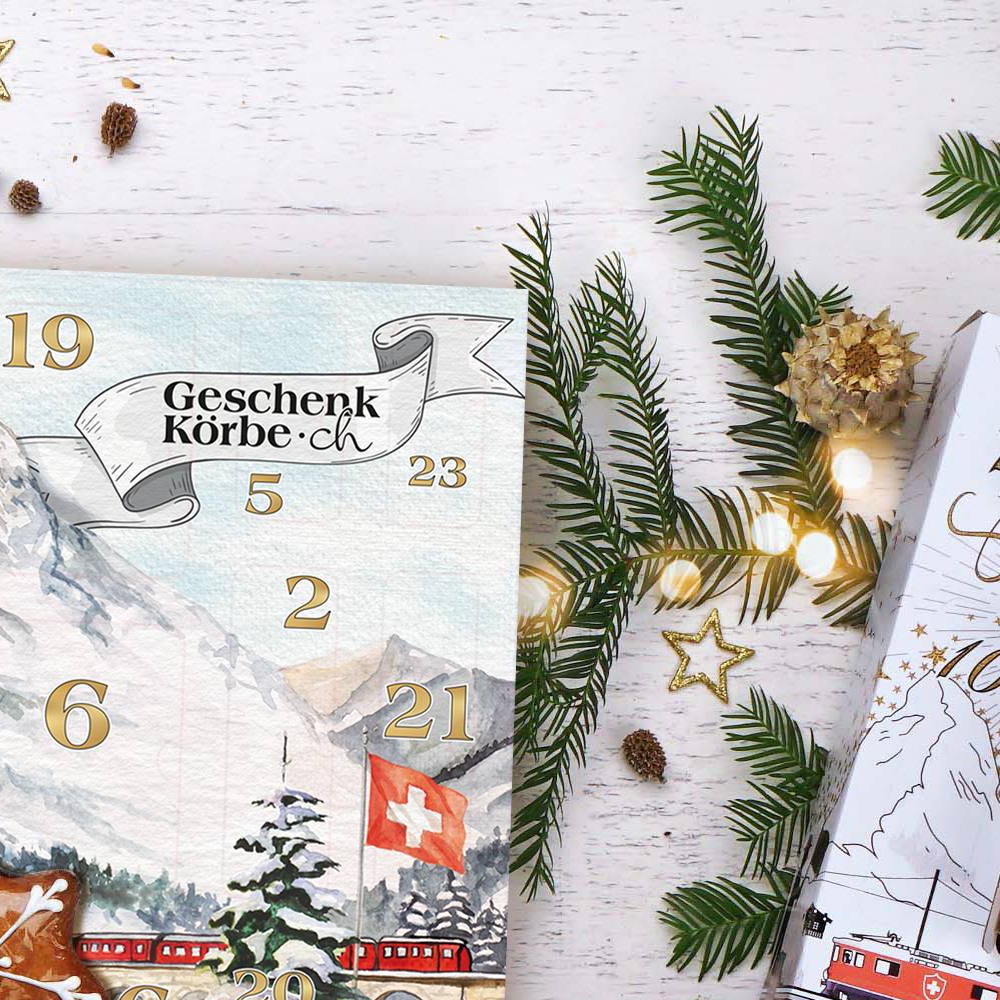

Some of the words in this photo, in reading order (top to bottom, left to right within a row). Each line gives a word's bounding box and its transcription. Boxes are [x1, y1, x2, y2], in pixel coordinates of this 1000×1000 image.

[3, 312, 95, 371] 19
[163, 381, 381, 419] Geschenk
[245, 473, 284, 515] 5
[408, 455, 468, 489] 23
[283, 575, 332, 631] 2
[44, 678, 112, 750] 6
[384, 682, 474, 742] 21
